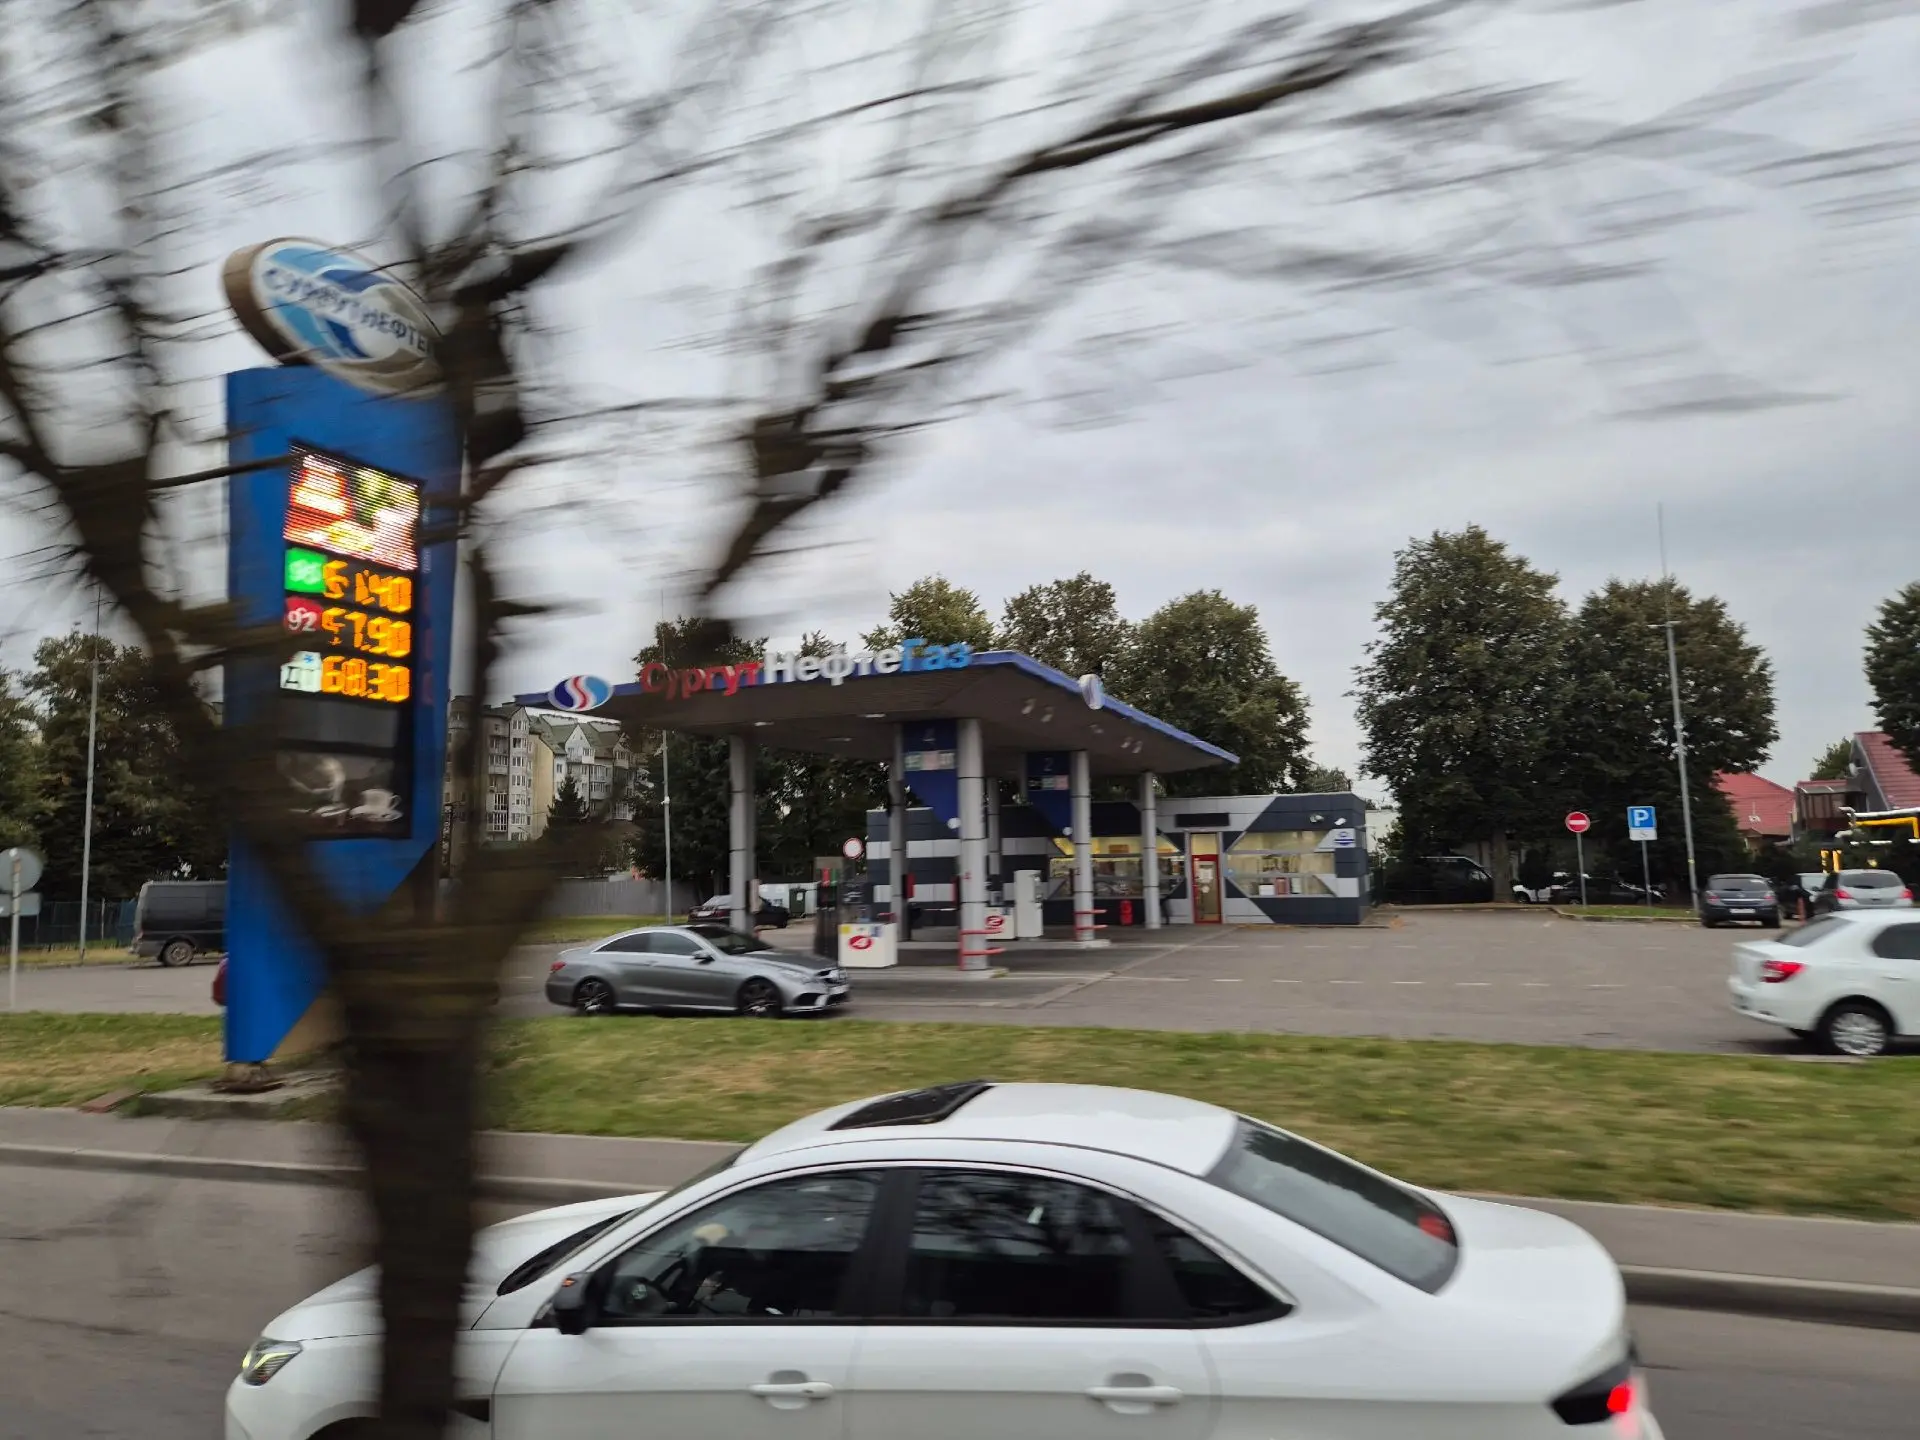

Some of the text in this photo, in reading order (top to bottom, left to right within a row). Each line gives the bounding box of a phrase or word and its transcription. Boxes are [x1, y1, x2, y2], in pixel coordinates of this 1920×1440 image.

[287, 607, 317, 633] 92
[1633, 809, 1649, 827] P
[851, 937, 868, 948] 4
